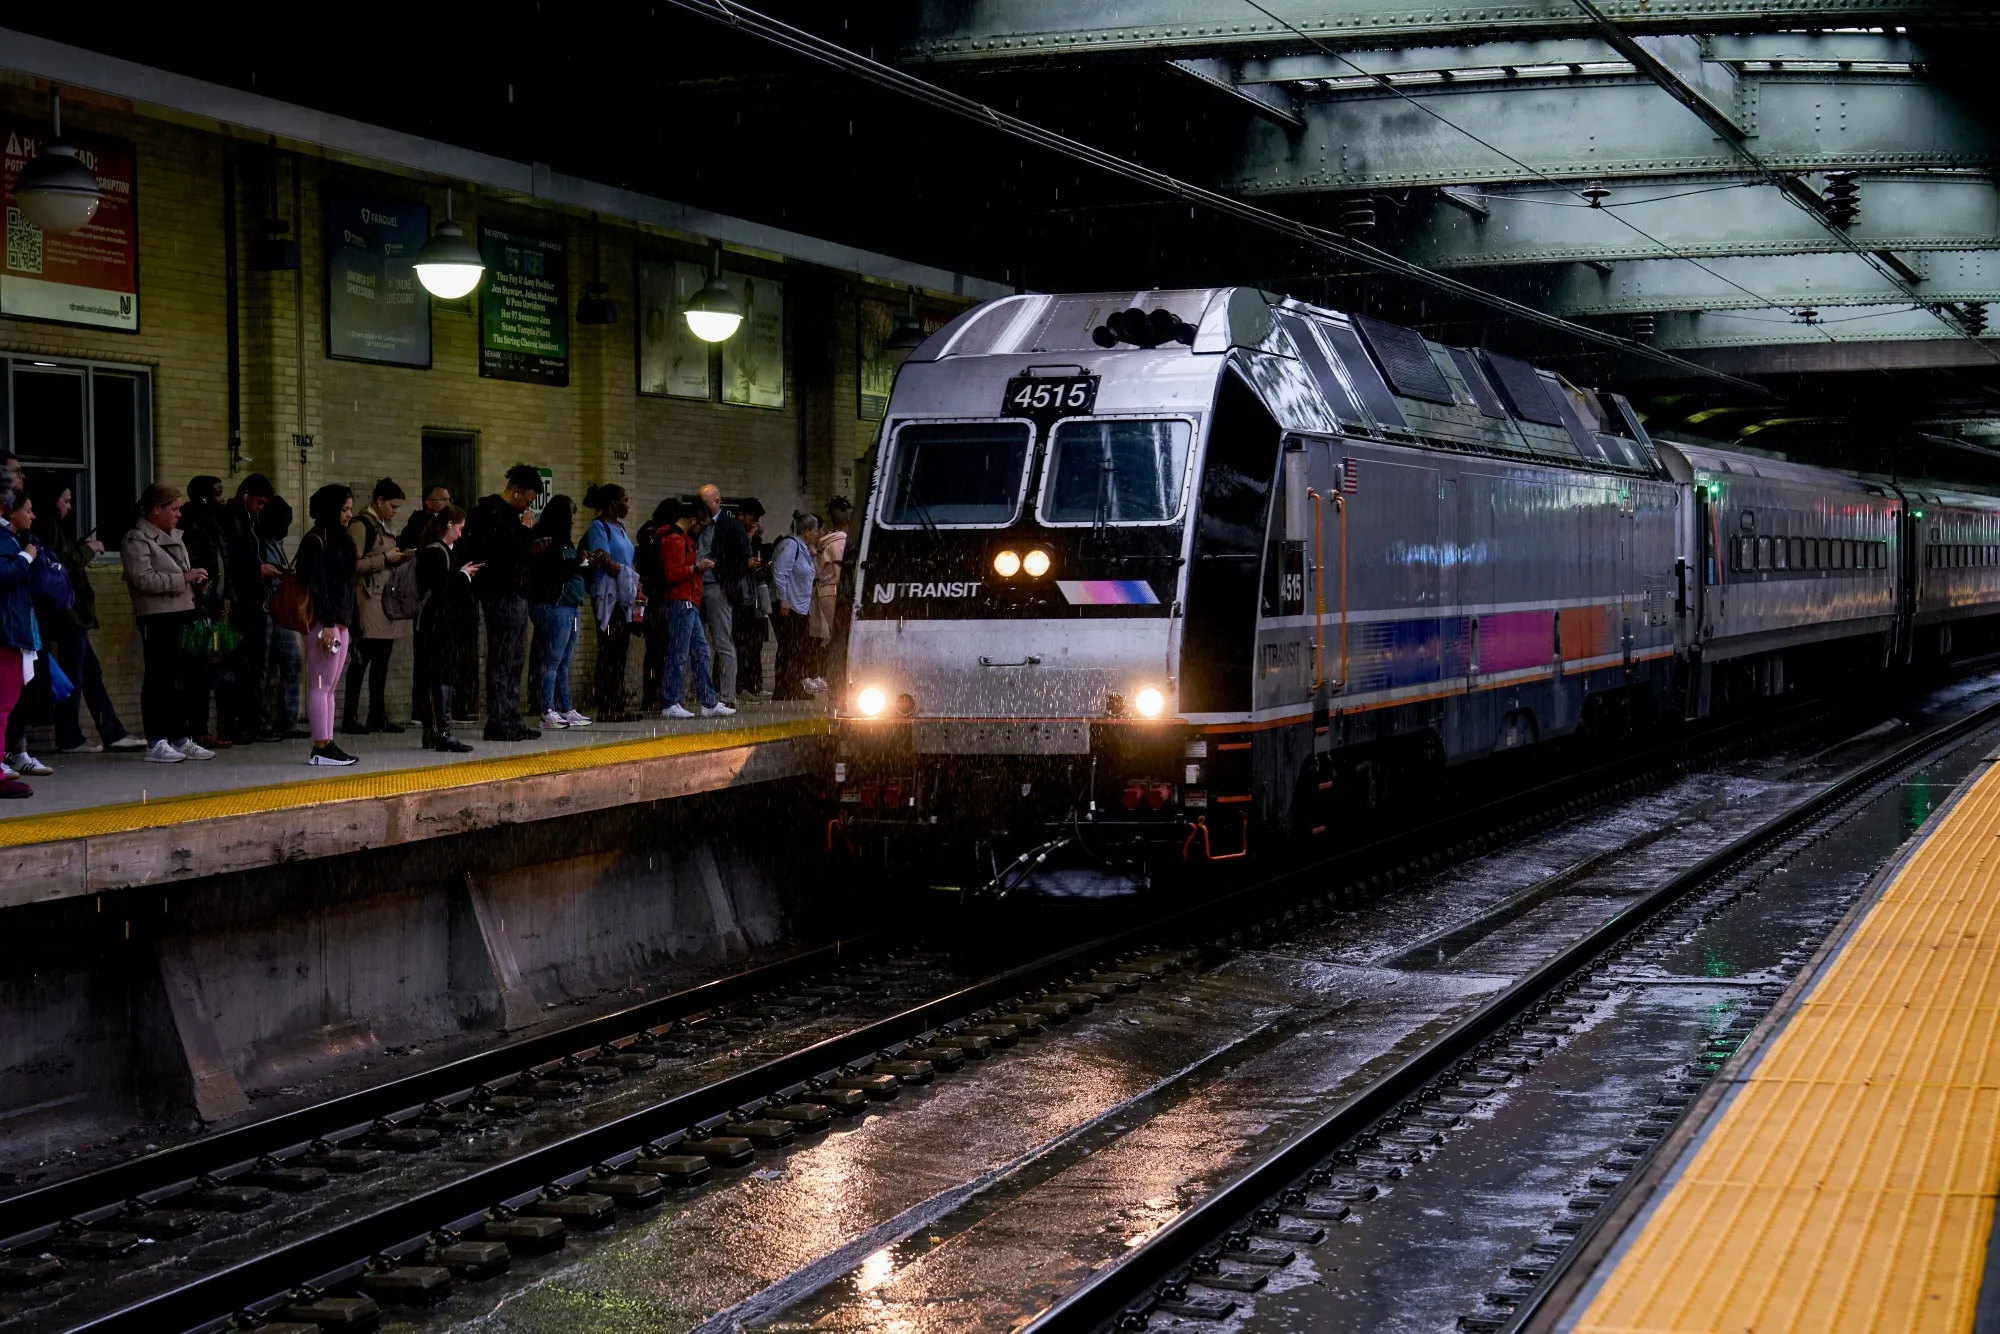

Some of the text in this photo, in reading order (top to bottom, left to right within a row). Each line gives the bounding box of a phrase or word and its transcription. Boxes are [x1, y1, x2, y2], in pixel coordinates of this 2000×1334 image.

[371, 213, 398, 227] FANDUEL
[496, 272, 508, 282] Tina
[509, 274, 518, 285] Fey
[523, 277, 535, 287] Amy
[492, 284, 501, 294] Jon
[525, 290, 537, 300] John
[511, 298, 522, 308] Pete
[523, 300, 545, 312] Davidson
[501, 309, 550, 325] Hot 97 Summer Jam
[502, 322, 550, 338] Stone Temple Pilots
[493, 333, 503, 343] The
[504, 335, 520, 348] String
[521, 338, 537, 348] Cheese
[1014, 384, 1087, 408] 4515
[292, 434, 314, 447] TRACK
[301, 450, 306, 465] 5
[614, 451, 630, 462] TRACK
[620, 463, 624, 475] 5
[845, 478, 848, 488] 5
[873, 582, 982, 604] NJ TRANSIT
[1280, 574, 1302, 602] 4515
[1267, 642, 1300, 668] TRANSIT
